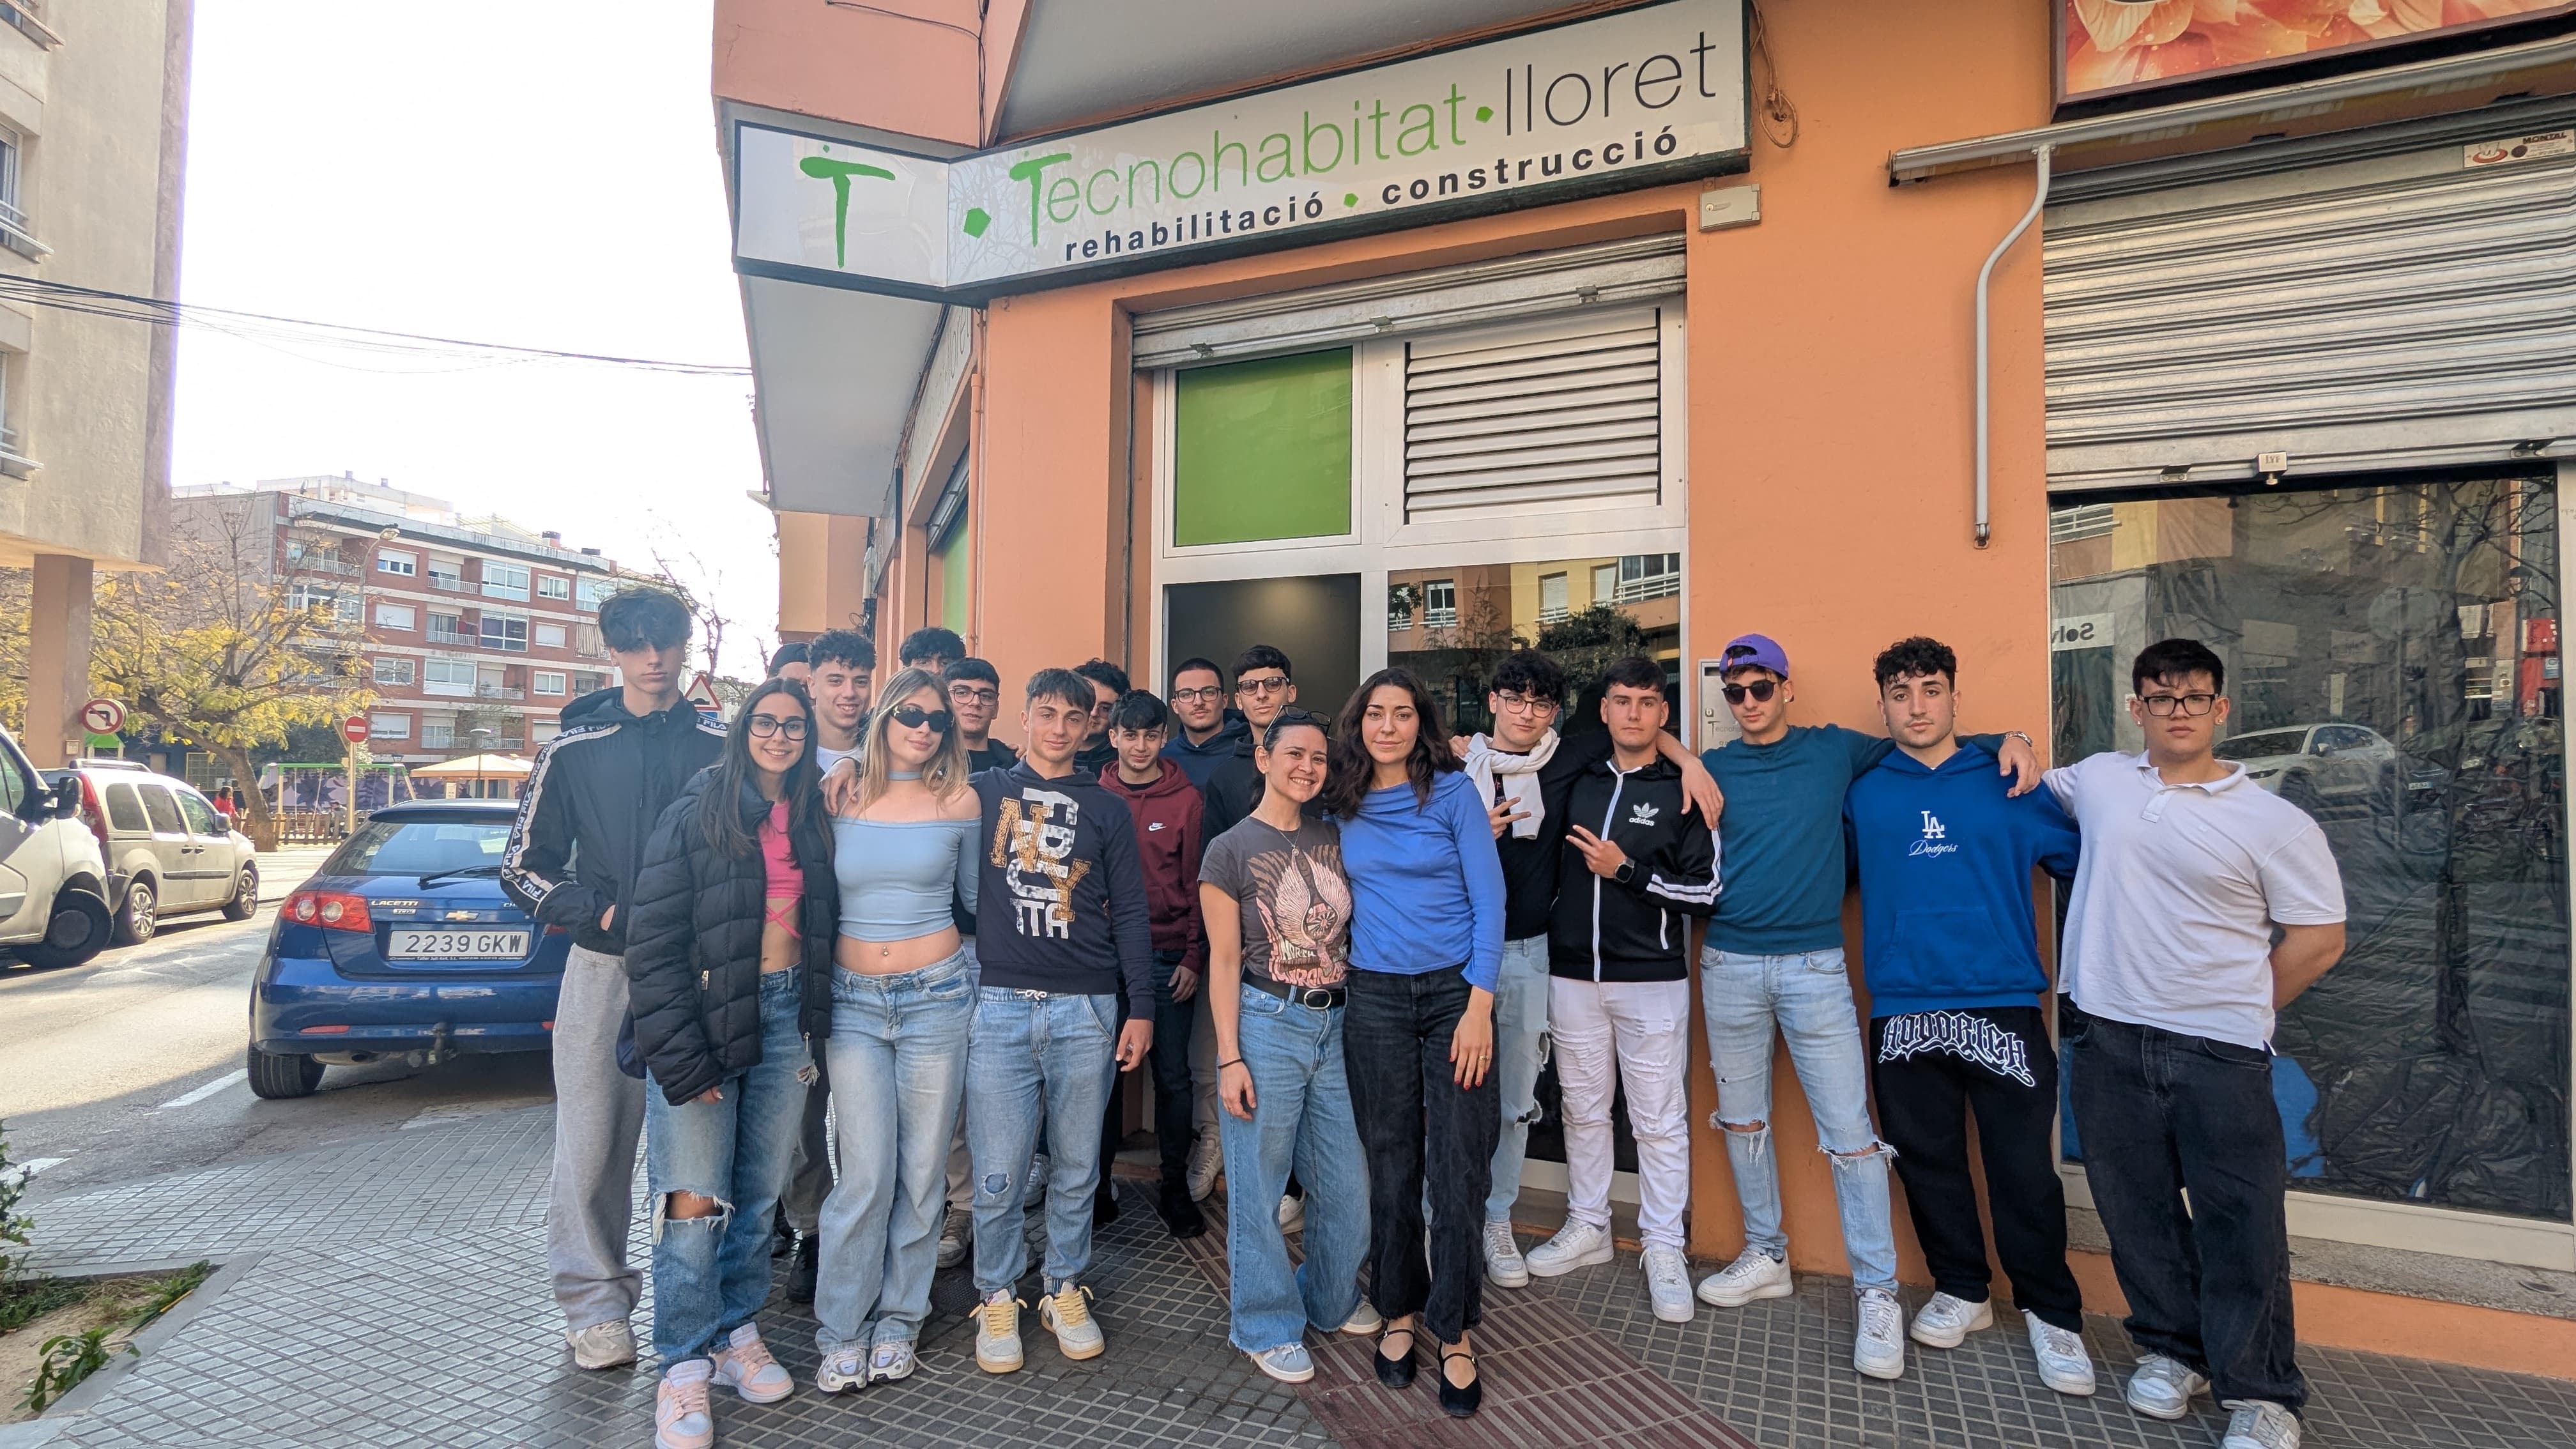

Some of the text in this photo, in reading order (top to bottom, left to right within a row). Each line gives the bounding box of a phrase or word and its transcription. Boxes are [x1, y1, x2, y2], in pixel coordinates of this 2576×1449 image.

[1009, 31, 1717, 247] Tecnohabitat lloret
[2522, 132, 2568, 144] MONTAL
[1065, 125, 1677, 262] rehabilitació construcció
[799, 144, 896, 268] T
[703, 719, 727, 730] FILA
[1629, 816, 1655, 827] adidas
[1921, 810, 1945, 839] LA
[1908, 839, 1958, 858] Dodgers
[522, 879, 542, 898] FILA
[405, 934, 523, 953] 2239 GKW
